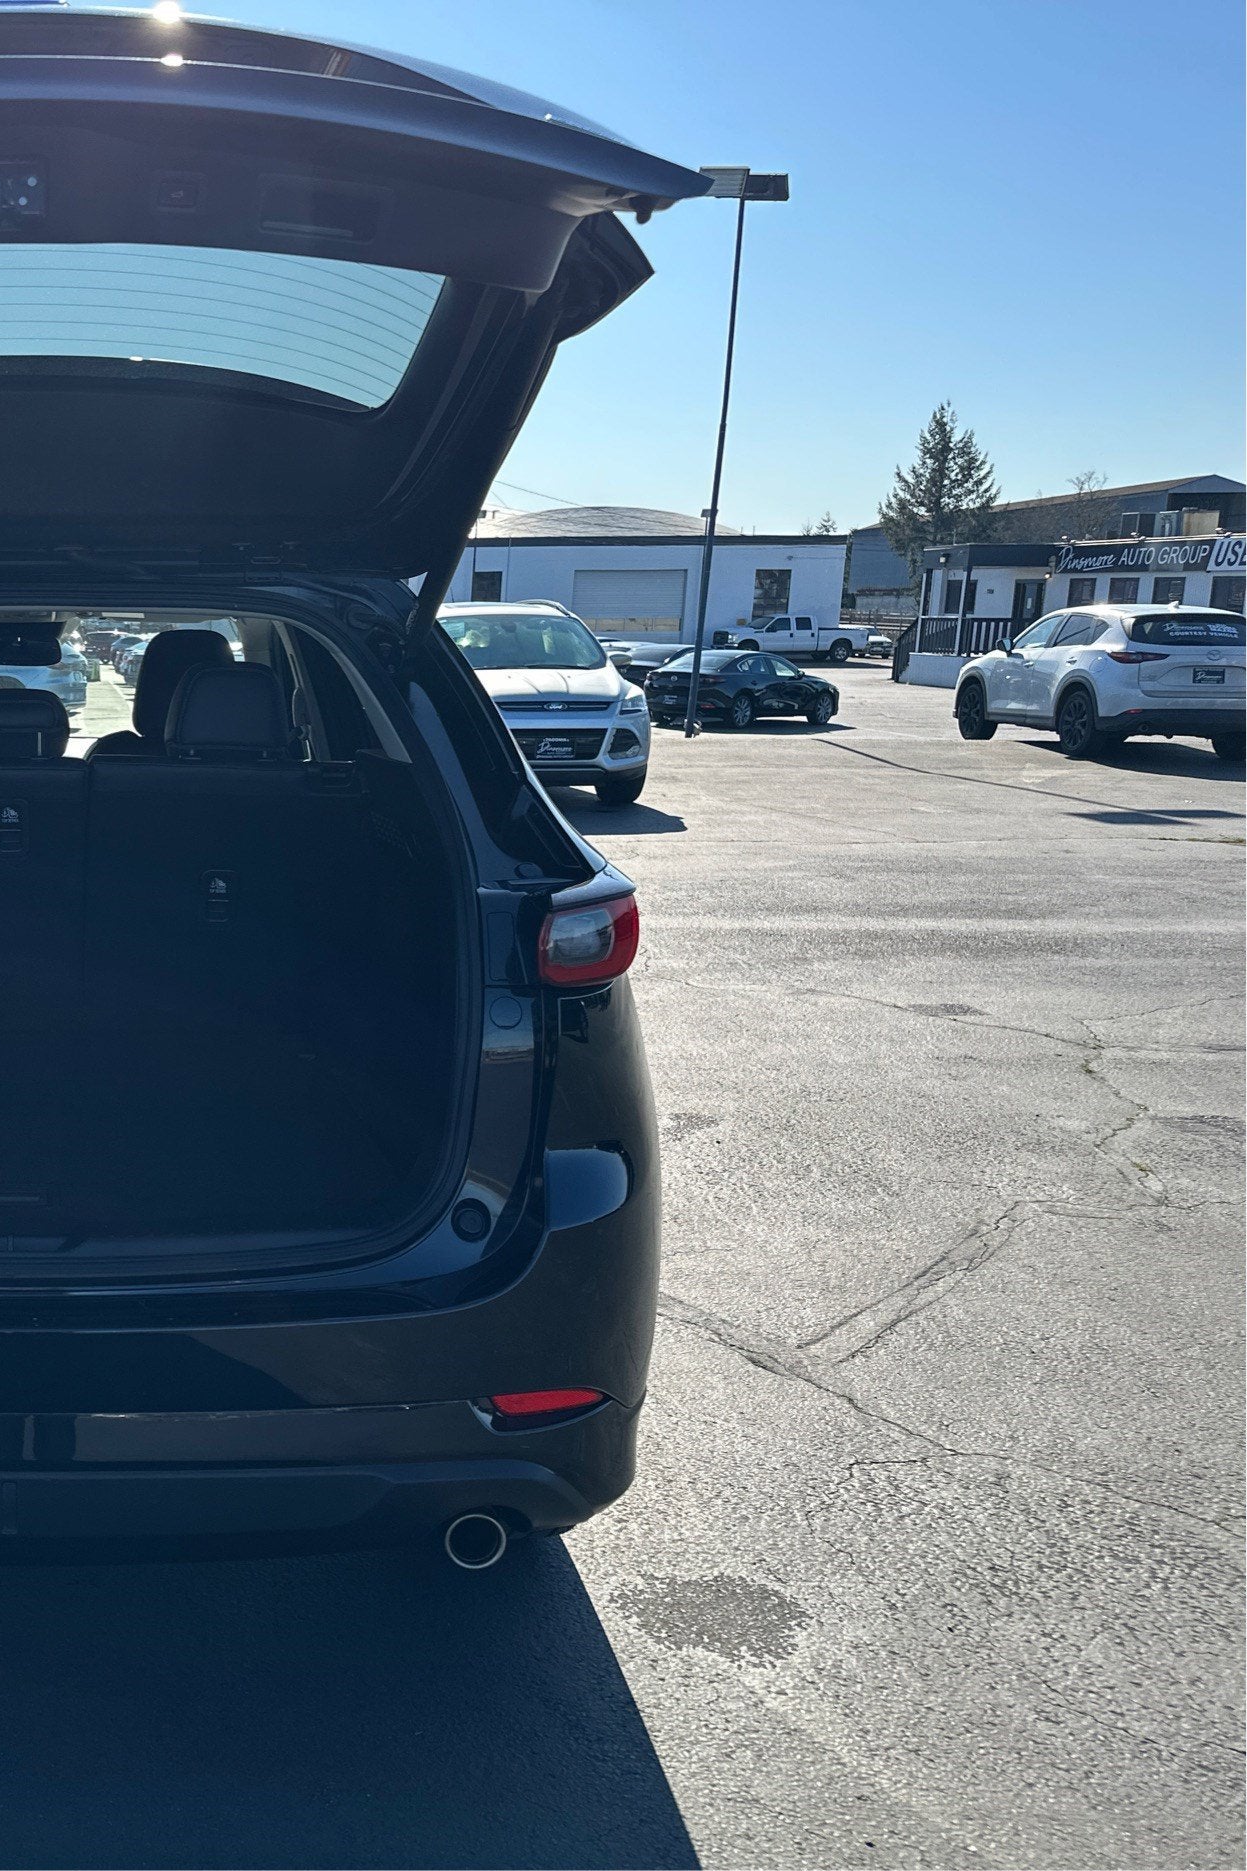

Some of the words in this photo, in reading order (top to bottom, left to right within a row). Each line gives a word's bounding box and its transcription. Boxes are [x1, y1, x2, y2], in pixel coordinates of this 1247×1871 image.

[1056, 546, 1118, 573] Dinsmore
[1117, 547, 1154, 566] AUTO
[1157, 545, 1210, 565] GROUP
[1209, 631, 1239, 639] VEHICLE
